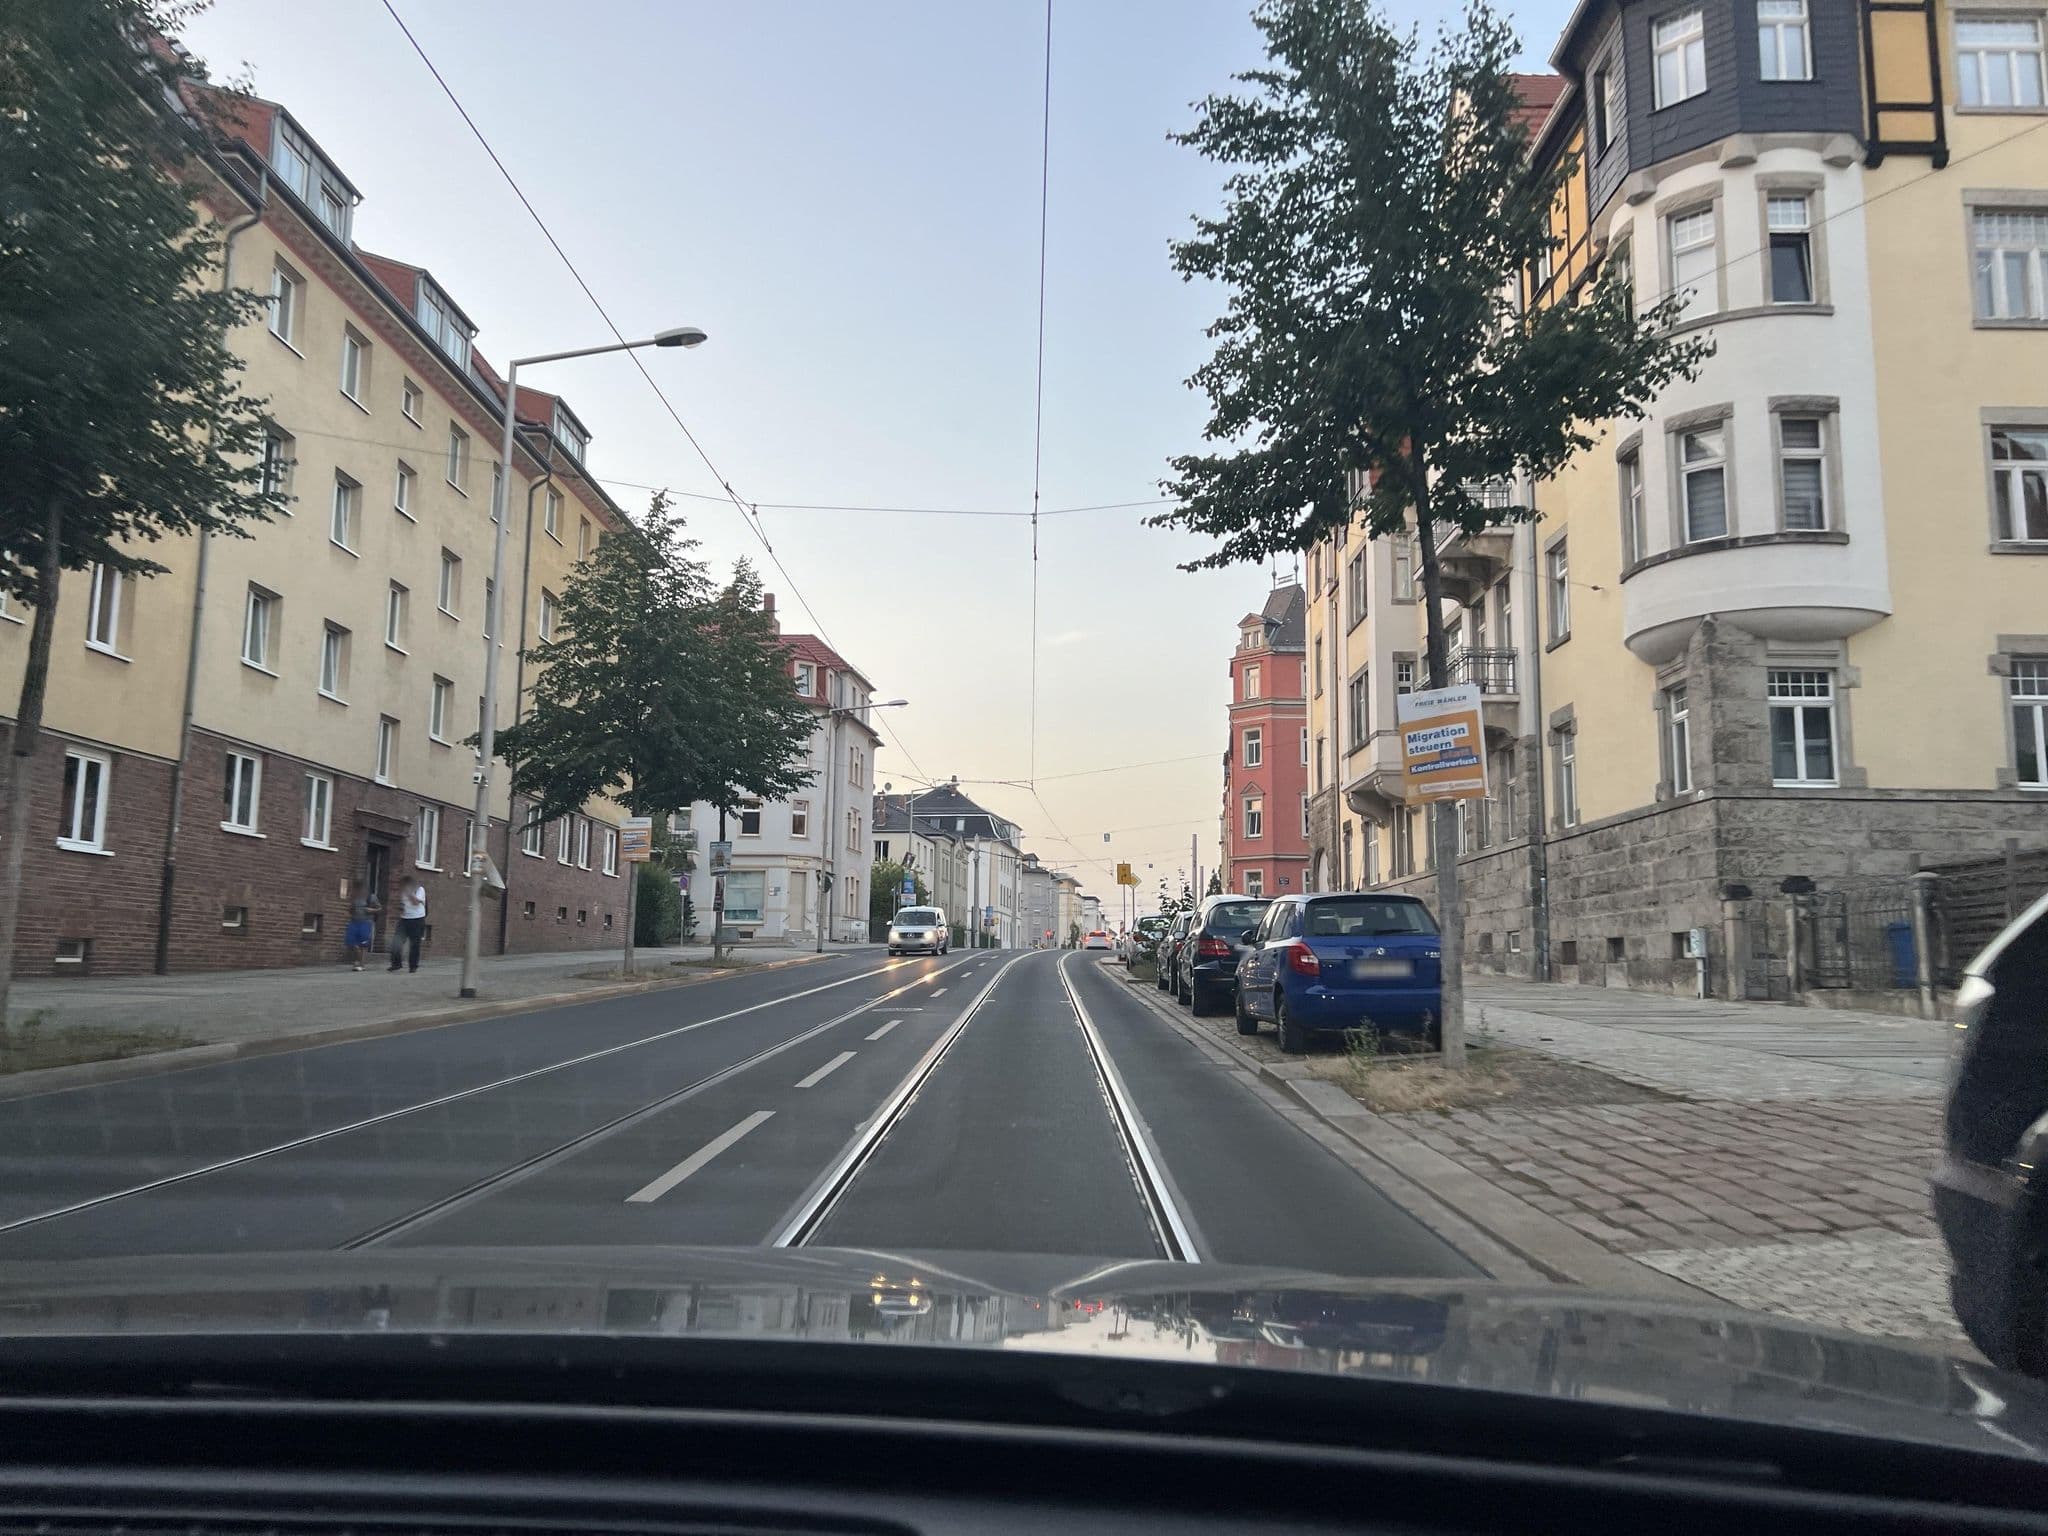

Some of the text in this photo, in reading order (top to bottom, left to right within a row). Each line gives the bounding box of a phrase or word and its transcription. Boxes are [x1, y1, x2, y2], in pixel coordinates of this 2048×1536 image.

[1408, 727, 1465, 743] Migration
[1409, 741, 1452, 755] steuern
[1411, 757, 1477, 773] Kontrollverlust
